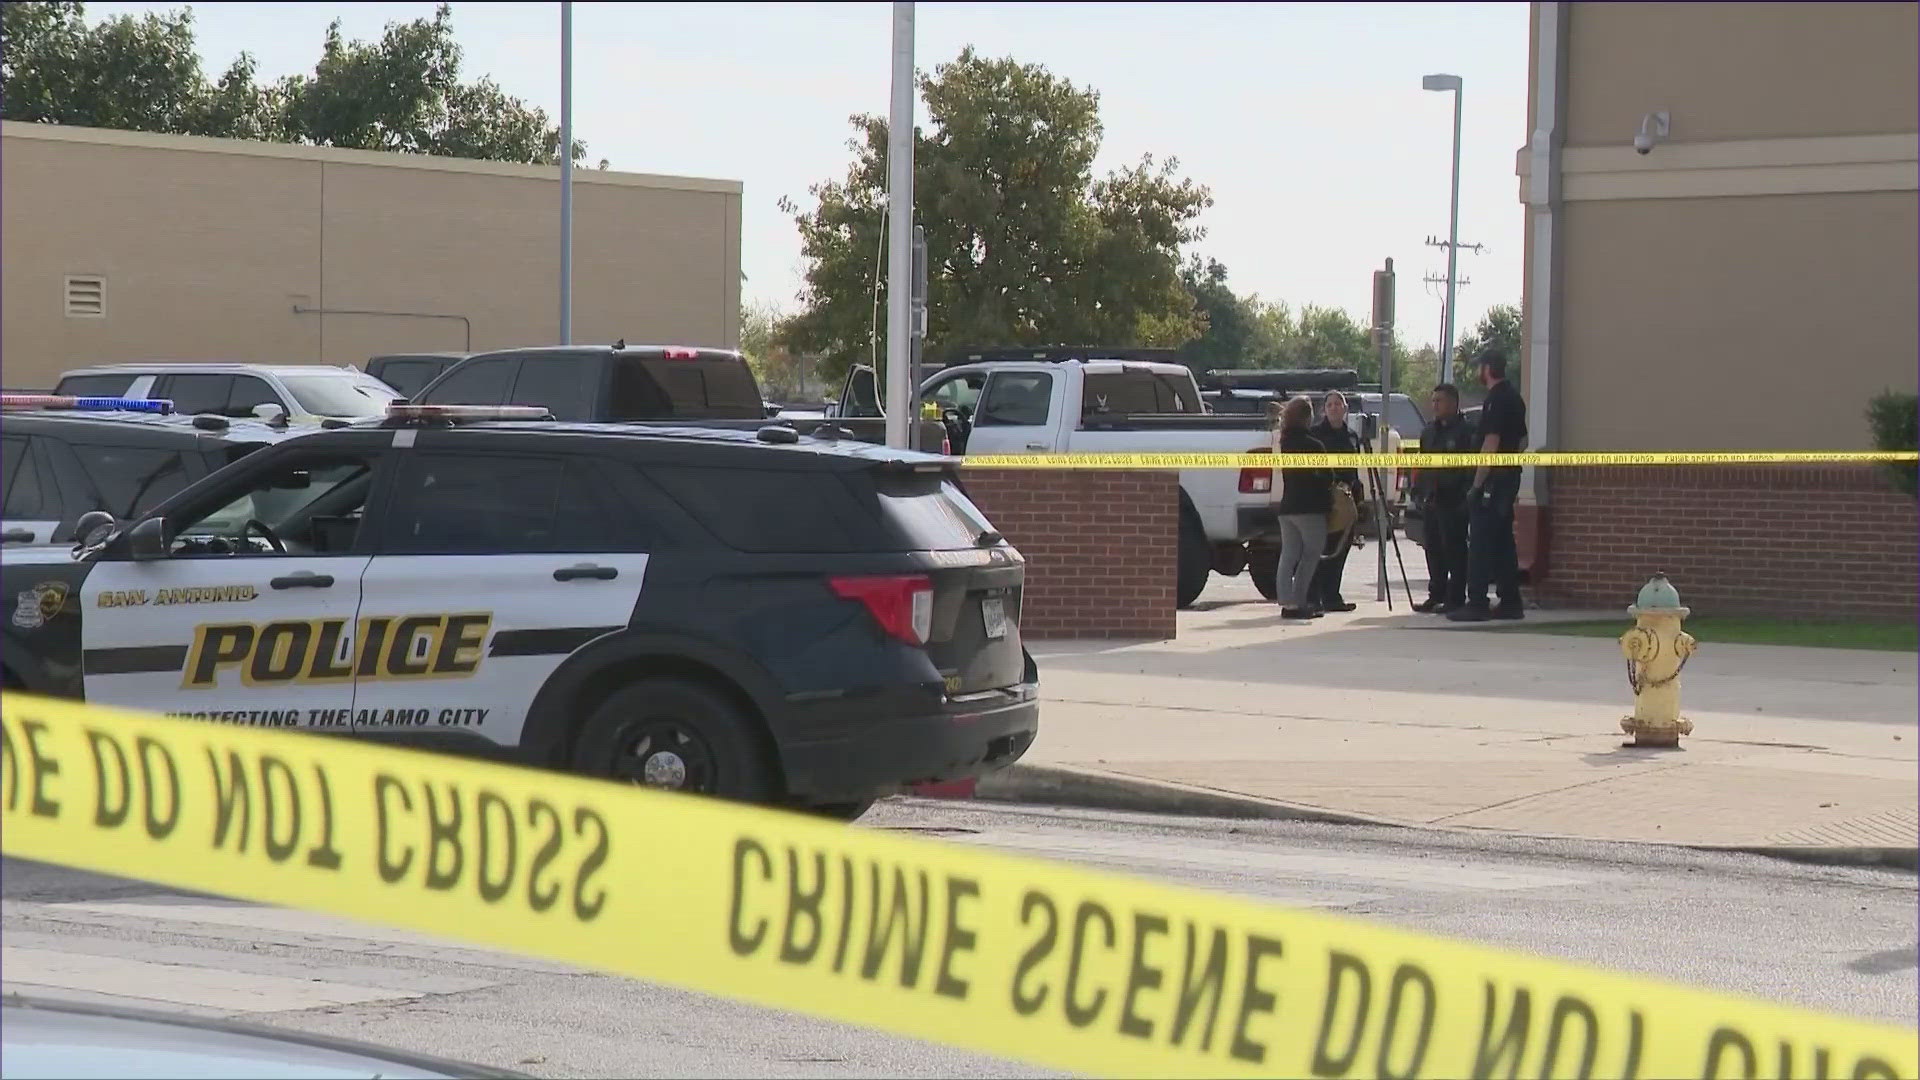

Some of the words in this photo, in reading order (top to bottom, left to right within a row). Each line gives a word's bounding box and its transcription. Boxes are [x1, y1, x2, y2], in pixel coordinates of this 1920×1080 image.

[98, 589, 147, 608] SAN
[153, 585, 258, 606] ANTONIO
[183, 611, 493, 688] POLICE
[165, 709, 299, 727] OTECTING
[308, 709, 350, 726] THE
[355, 709, 430, 726] ALAMO
[438, 709, 490, 726] CITY
